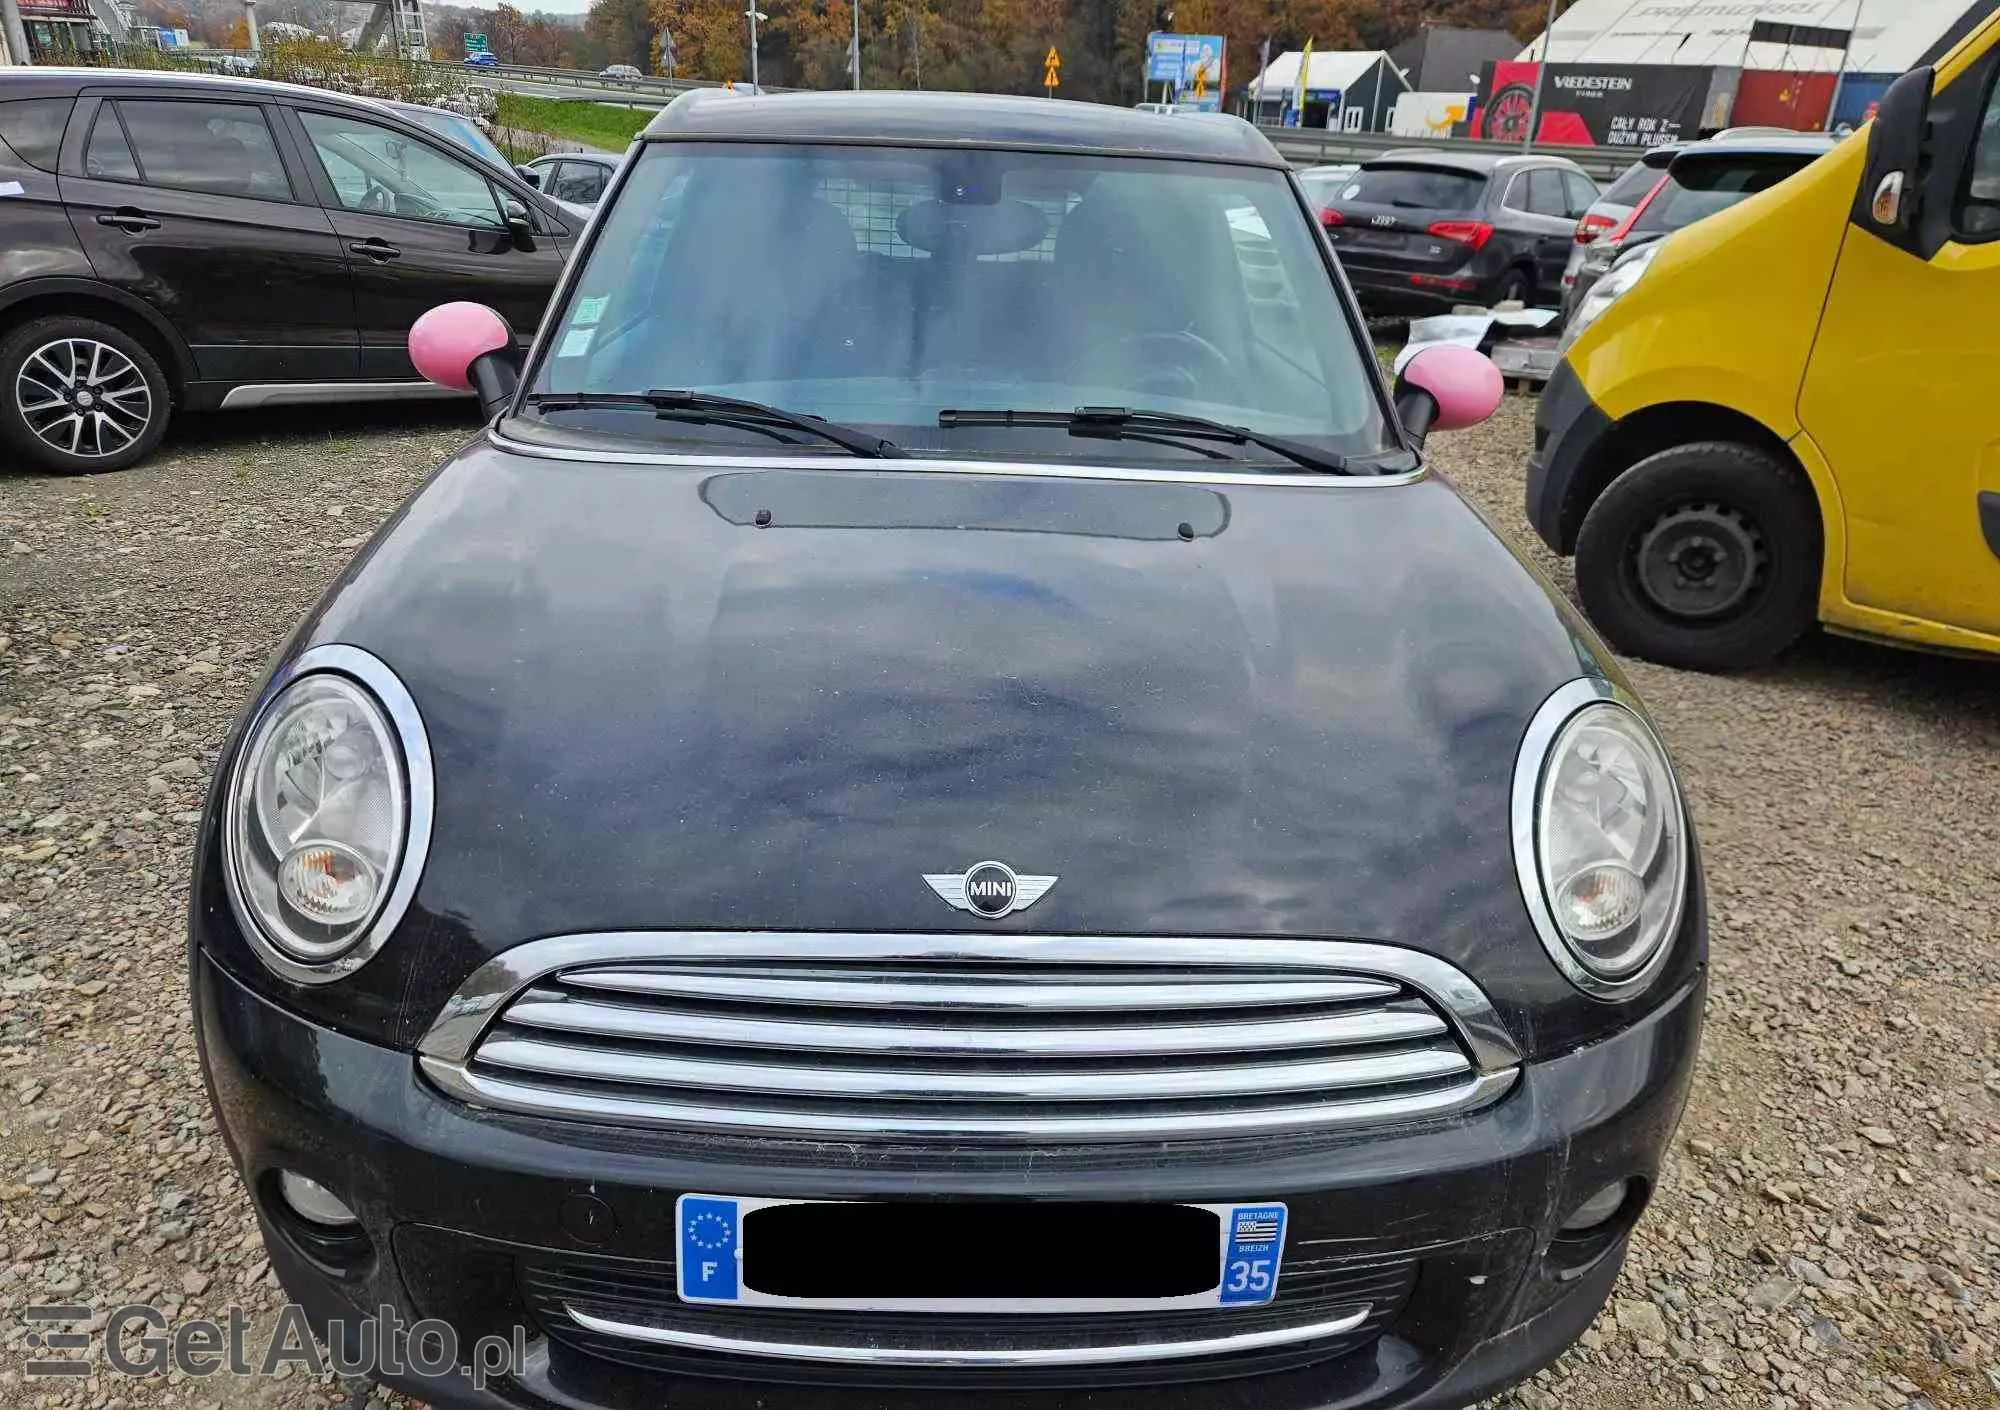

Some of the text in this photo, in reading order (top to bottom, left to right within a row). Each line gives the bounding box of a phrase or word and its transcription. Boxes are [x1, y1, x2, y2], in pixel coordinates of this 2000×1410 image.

[1554, 76, 1633, 90] VREDESTEIN
[969, 880, 1013, 897] MINI
[1238, 1211, 1281, 1220] BRETAGNE
[1239, 1244, 1270, 1253] BREIZH
[702, 1261, 718, 1282] F
[1228, 1259, 1271, 1291] 35
